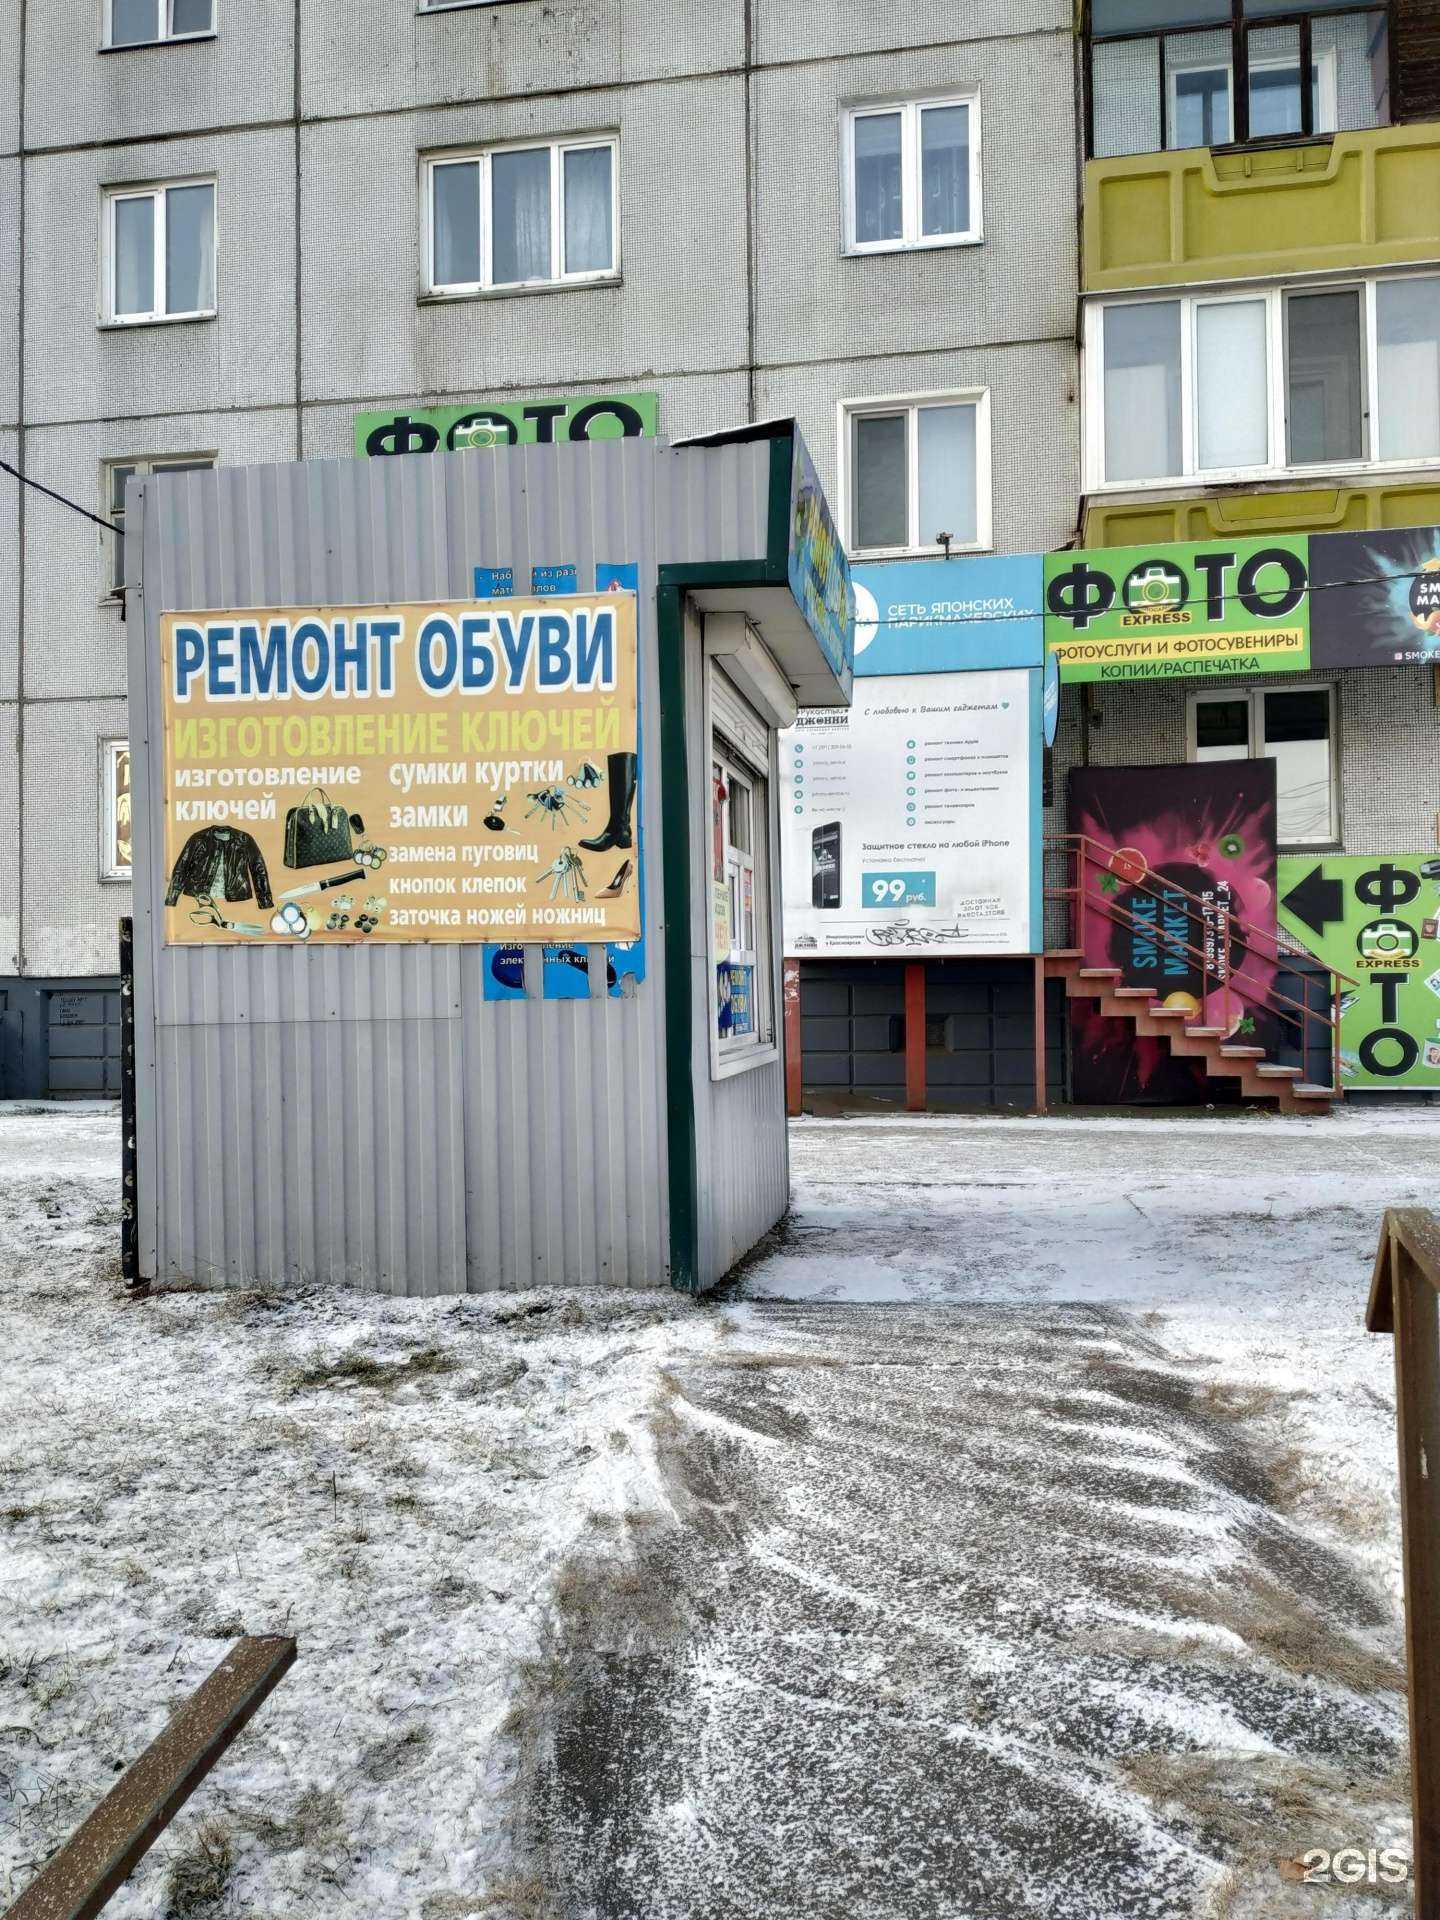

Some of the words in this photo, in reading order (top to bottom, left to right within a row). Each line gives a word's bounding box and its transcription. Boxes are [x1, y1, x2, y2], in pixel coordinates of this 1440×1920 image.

[1047, 548, 1308, 630] ФОТО
[888, 604, 926, 617] СЕТЬ
[931, 598, 1015, 614] ЯПОНСКИХ
[888, 608, 1035, 629] ПАРИКМАХЕРСКИХ
[1123, 612, 1191, 626] EXPRESS
[174, 618, 402, 699] РЕМОНТ
[418, 610, 614, 692] ОБУВИ
[1157, 641, 1168, 653] И
[1173, 633, 1298, 653] ФОТОСУВЕНИРЫ
[1101, 657, 1260, 679] КОПИИ/РАСПЕЧАТКА
[920, 705, 951, 713] Вашим
[174, 709, 449, 760] ИЗГОТОВЛЕНИЕ
[460, 697, 621, 755] КЛЮЧЕЙ
[175, 764, 362, 788] изготовление
[389, 760, 467, 792] сумки
[475, 757, 564, 792] куртки
[175, 792, 277, 822] ключей
[389, 804, 469, 828] замки
[388, 846, 456, 864] замена
[462, 844, 539, 868] пуговиц
[389, 877, 456, 895] кнопок
[461, 875, 528, 894] клепок
[872, 879, 906, 903] 99
[389, 907, 461, 928] заточка
[466, 902, 527, 926] ножей
[532, 903, 607, 929] ножниц
[1356, 959, 1420, 968] EXPRESS
